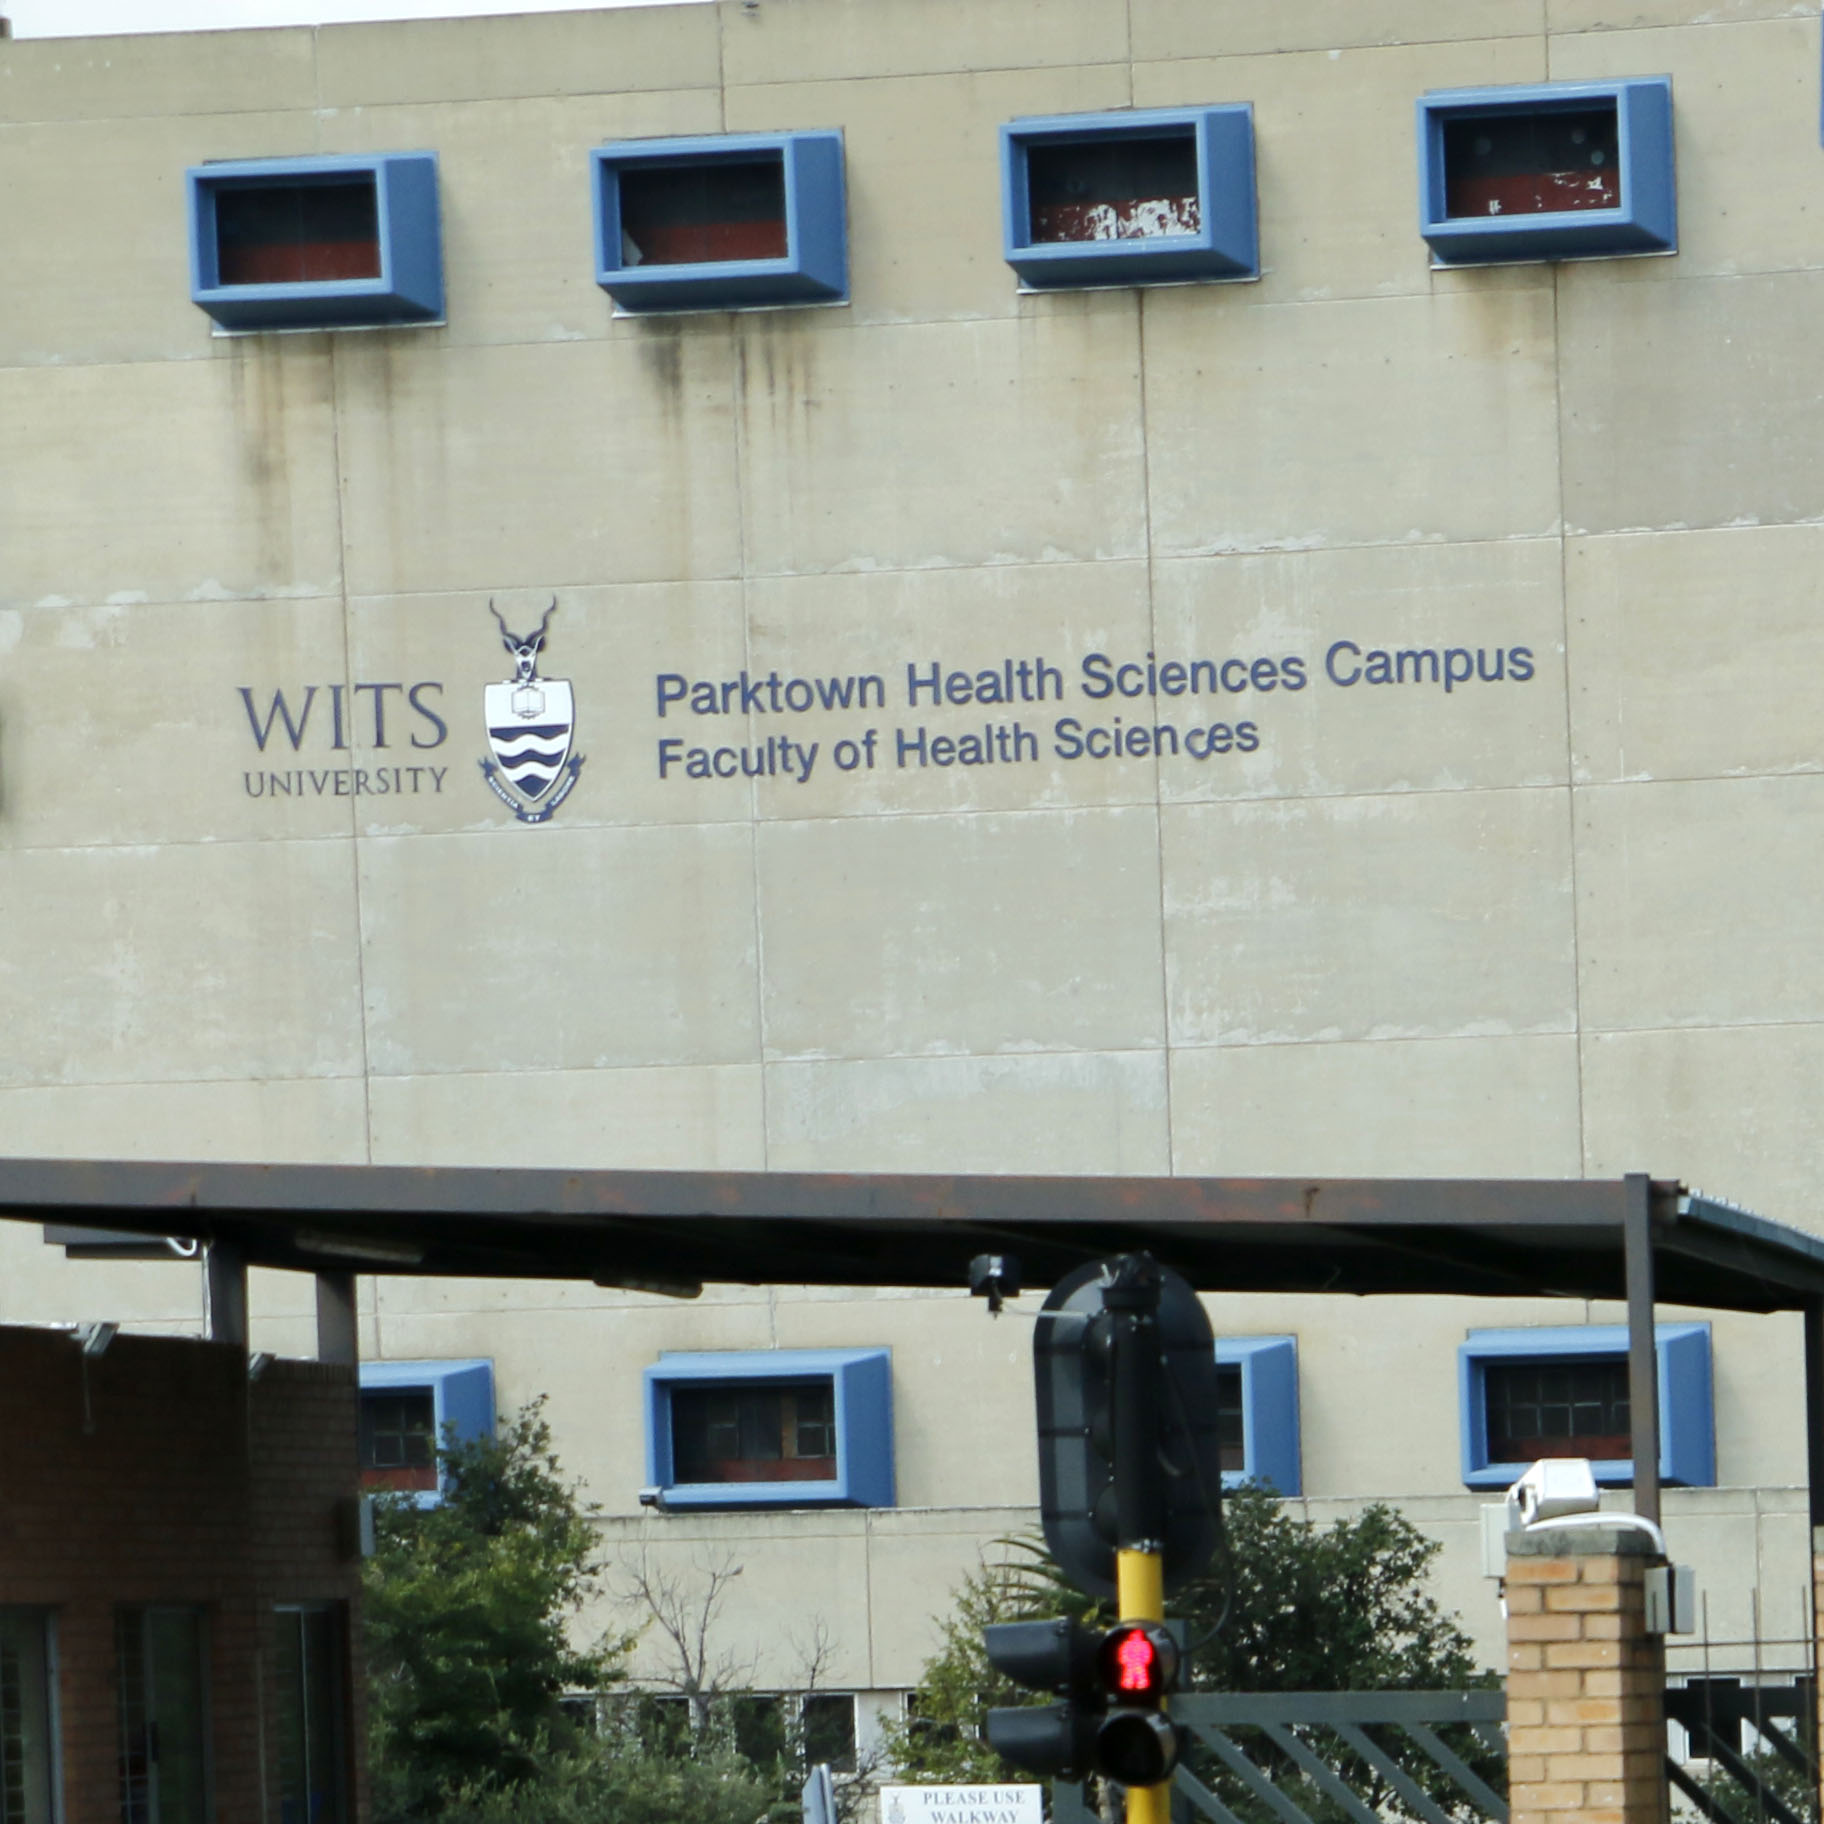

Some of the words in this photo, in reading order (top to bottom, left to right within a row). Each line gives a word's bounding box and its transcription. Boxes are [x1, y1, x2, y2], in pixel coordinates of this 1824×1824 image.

[655, 670, 886, 718] Parktown
[906, 656, 1064, 708] Health
[1080, 650, 1308, 700] Sciences
[1324, 639, 1536, 694] Campus
[235, 680, 449, 752] WITS
[657, 735, 820, 783] Faculty
[832, 727, 878, 772] of
[896, 721, 1039, 768] Health
[1053, 715, 1261, 761] Sciences
[243, 765, 449, 798] UNIVERSITY
[922, 1790, 988, 1806] PLEASE
[992, 1789, 1026, 1805] USE
